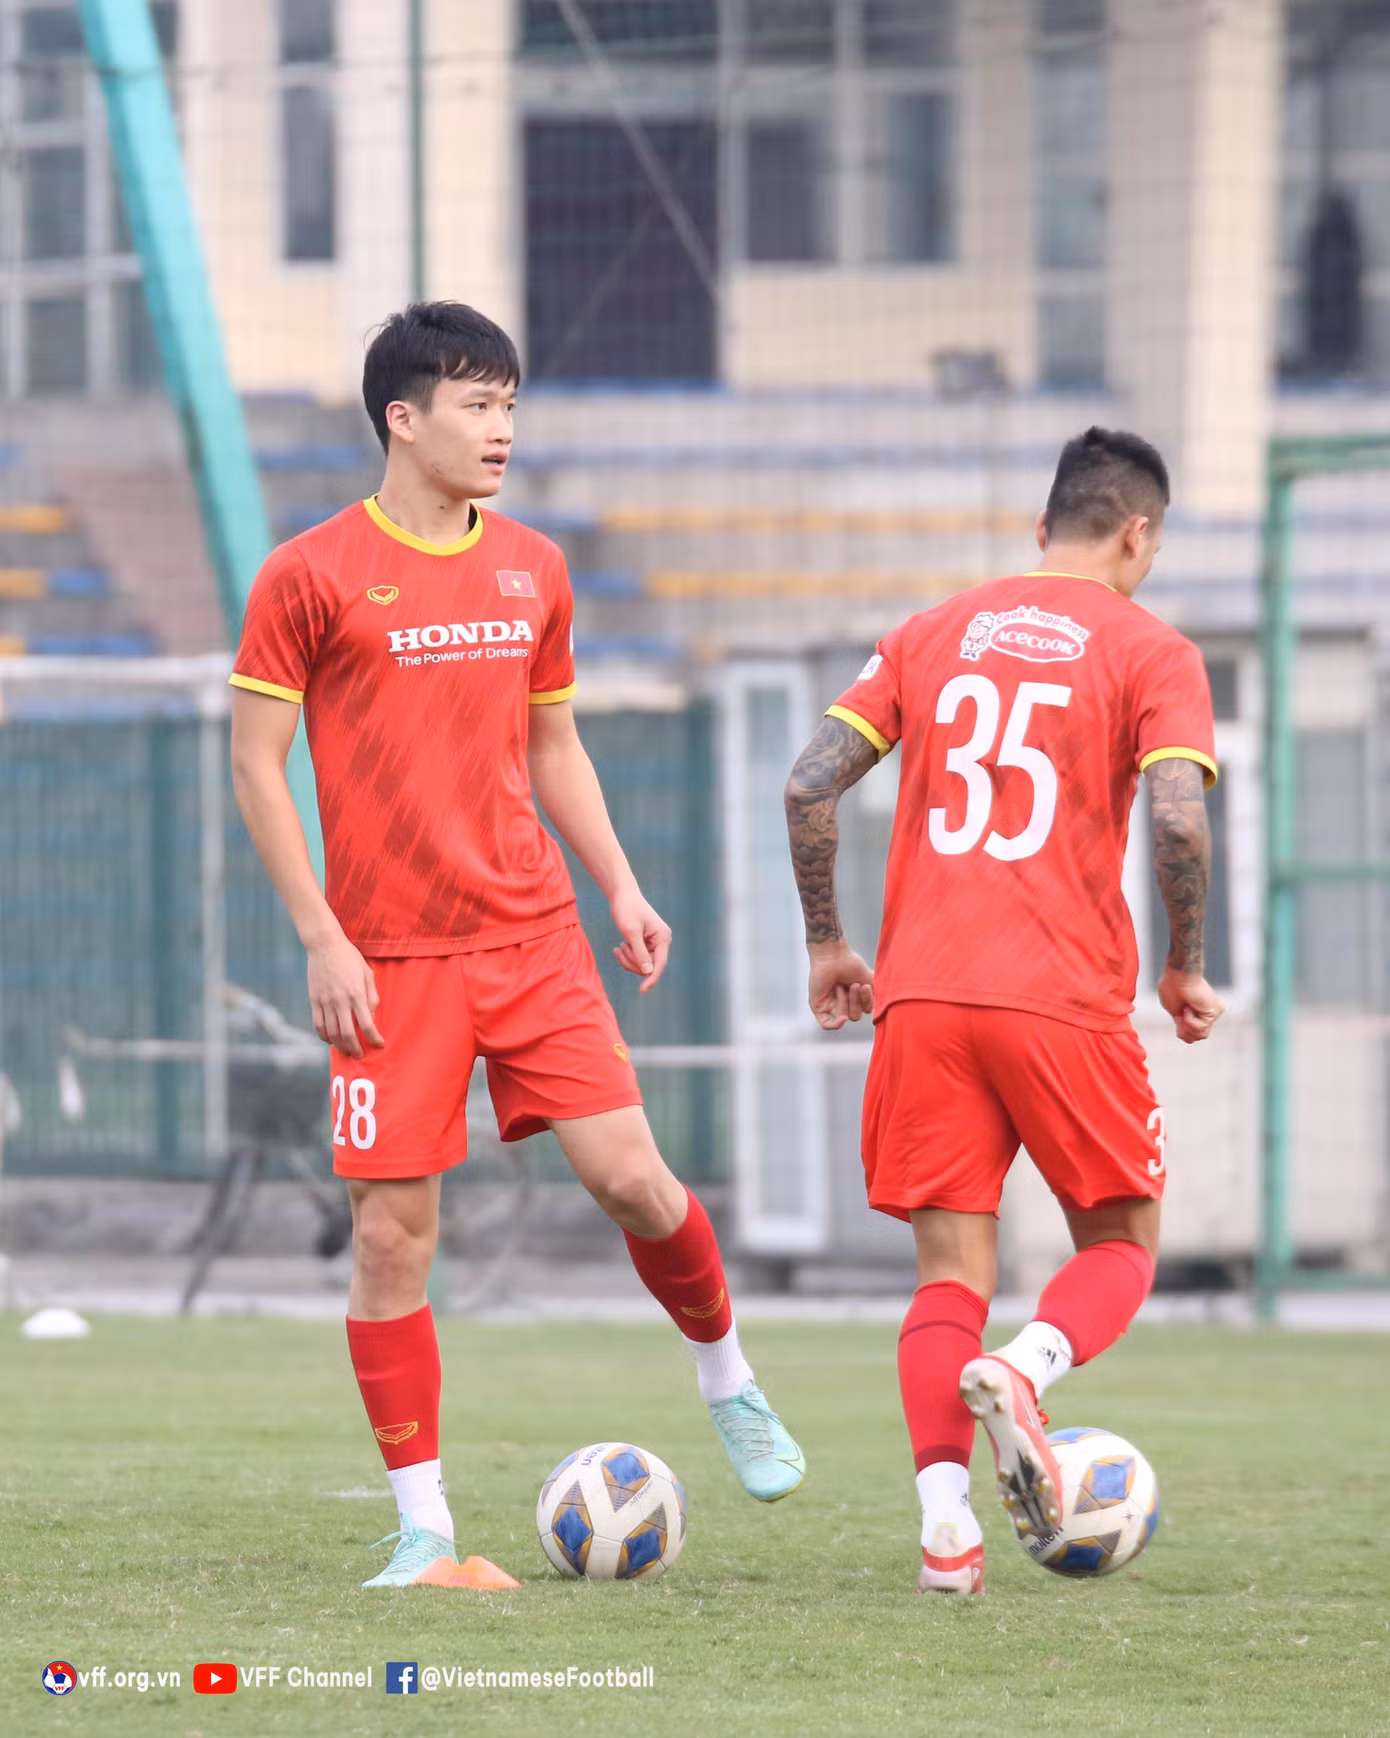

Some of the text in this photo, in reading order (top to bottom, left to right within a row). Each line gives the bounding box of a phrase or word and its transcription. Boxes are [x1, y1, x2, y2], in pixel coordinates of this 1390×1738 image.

[387, 620, 534, 653] HONDA
[1030, 607, 1088, 640] happiness
[395, 647, 529, 667] The Power of Dreams
[928, 674, 1072, 861] 35
[332, 1075, 377, 1150] 28
